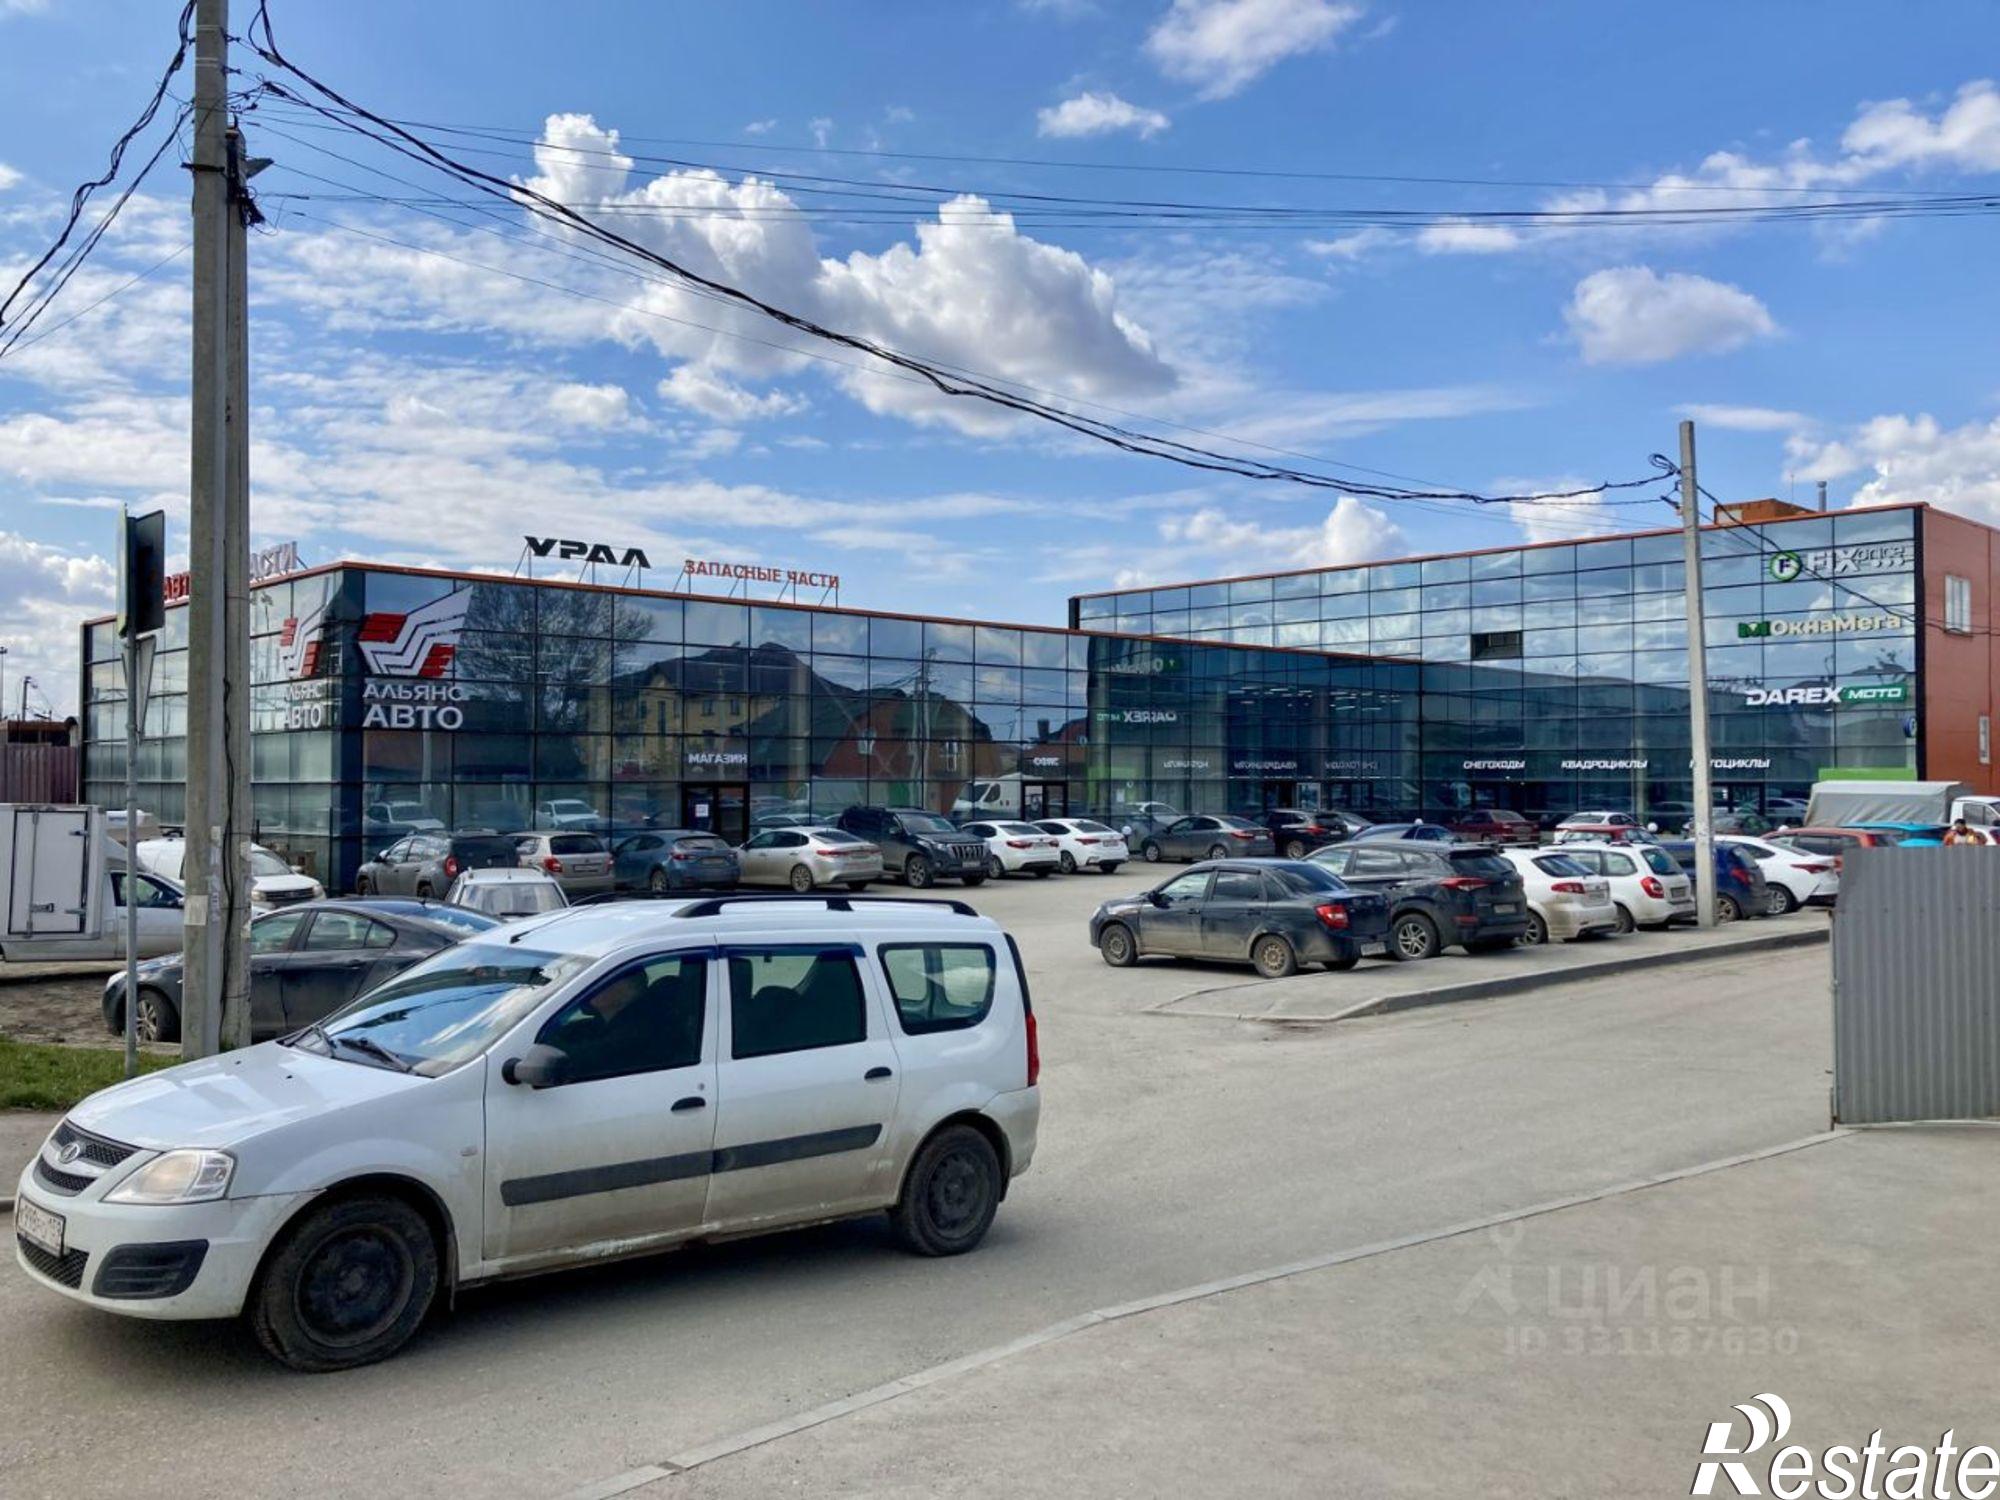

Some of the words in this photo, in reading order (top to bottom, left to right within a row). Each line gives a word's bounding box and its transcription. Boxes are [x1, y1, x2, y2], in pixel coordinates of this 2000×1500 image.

[524, 536, 651, 568] УРАЛ
[1807, 549, 1860, 573] FIX
[684, 559, 781, 582] ЗАПАСНЫЕ
[787, 569, 840, 588] ЧАСТИ
[1770, 614, 1901, 636] ОкнаМега
[362, 683, 464, 700] АЛЬЯНС
[1745, 687, 1843, 705] DAREX
[284, 704, 322, 728] АВТО
[362, 704, 464, 730] АВТО
[688, 753, 748, 764] МАГАЗИН
[1463, 760, 1525, 770] СНЕГОХОДЫ
[1561, 760, 1648, 769] КВАДРОЦИКЛЫ
